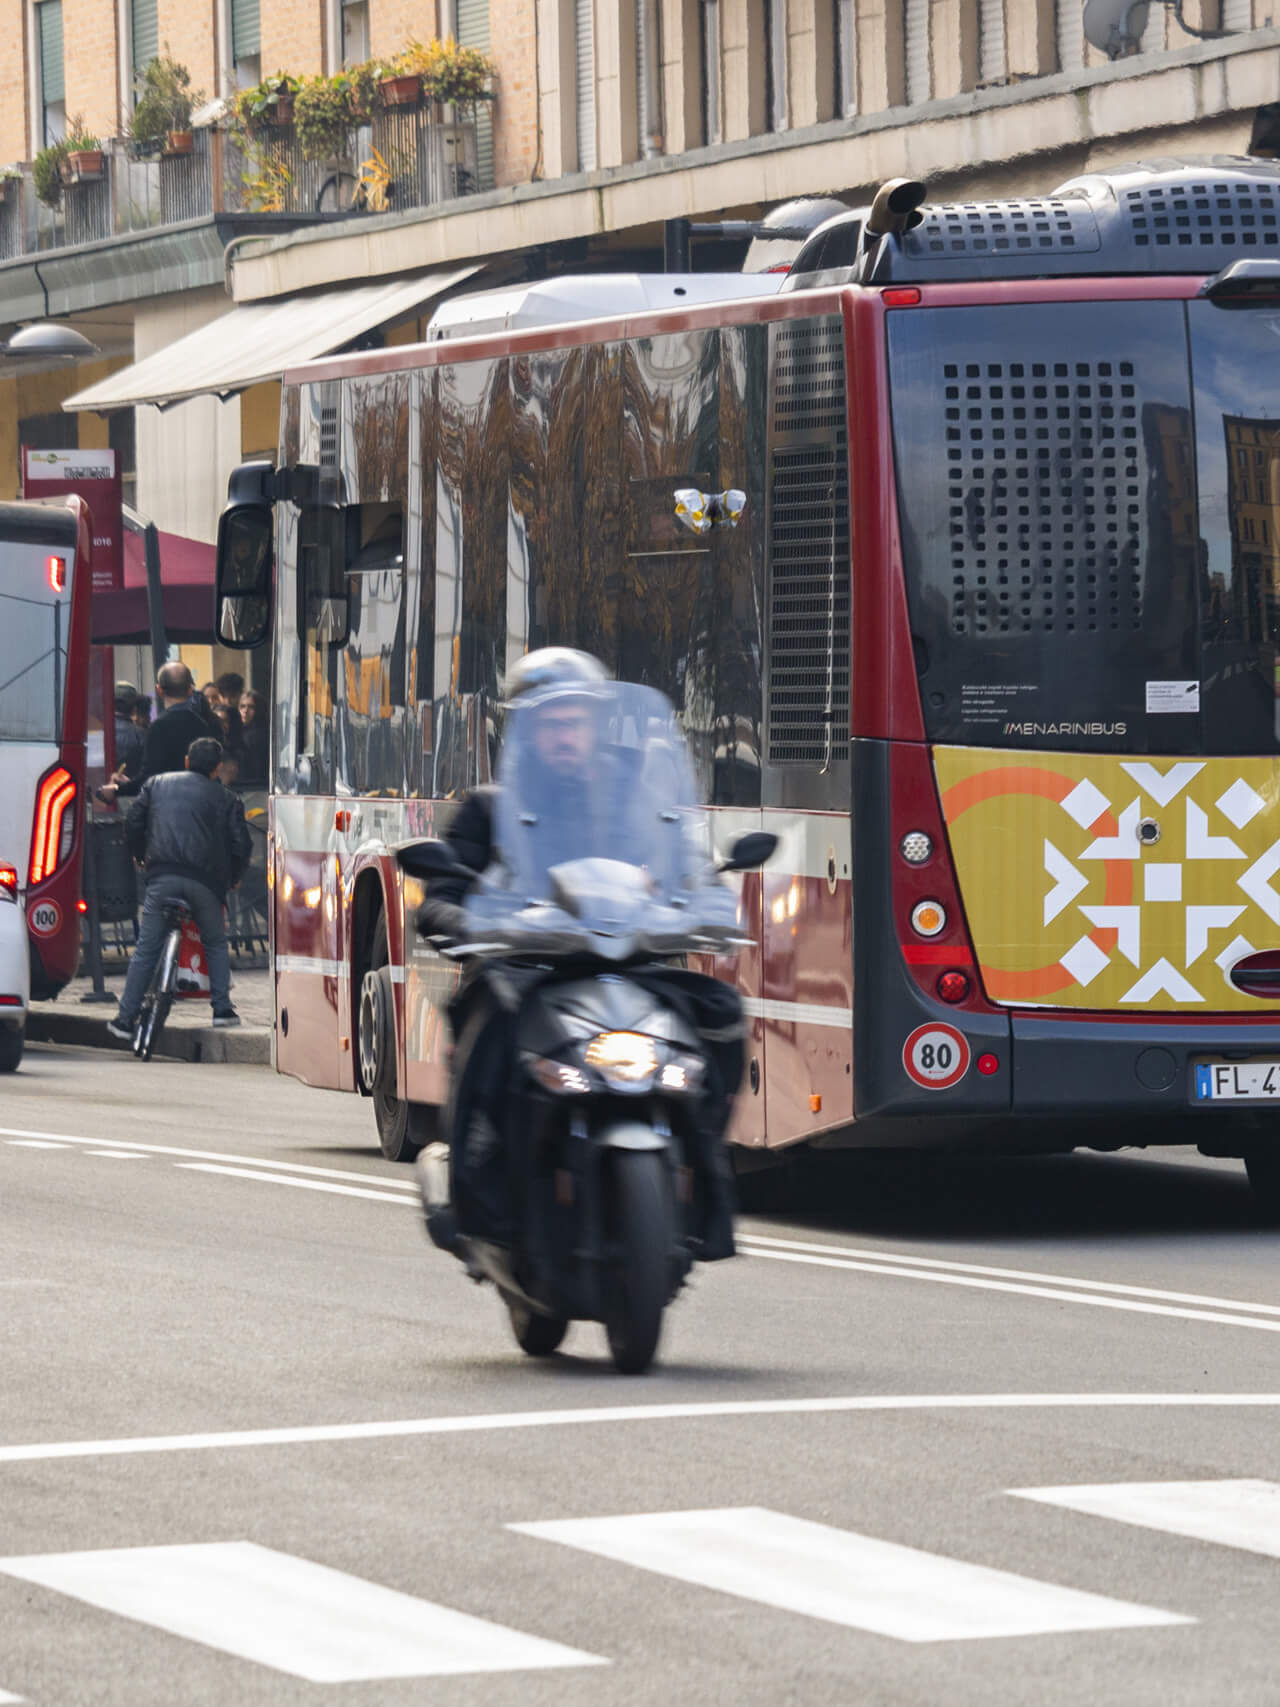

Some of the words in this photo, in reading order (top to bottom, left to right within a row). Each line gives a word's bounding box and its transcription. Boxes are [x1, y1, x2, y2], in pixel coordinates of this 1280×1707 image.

[36, 910, 56, 925] 100
[921, 1043, 952, 1069] 80
[1215, 1066, 1249, 1095] FL
